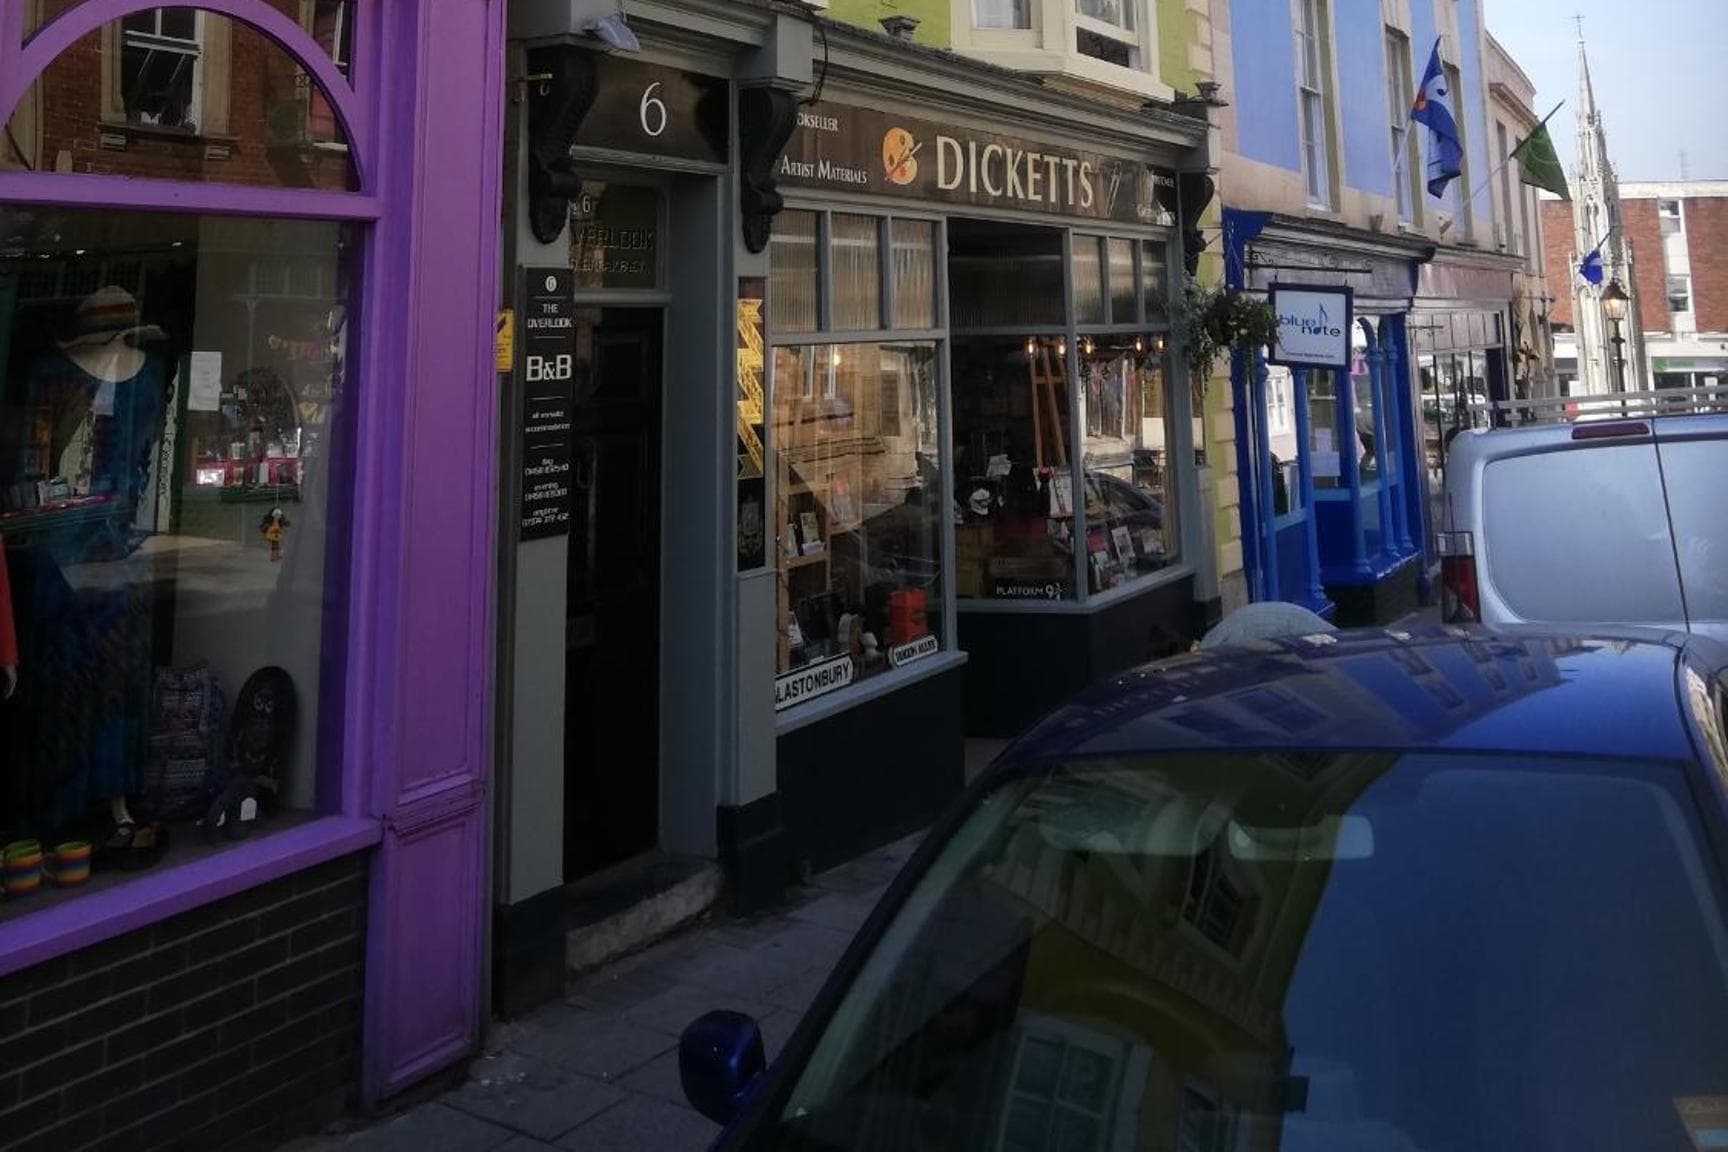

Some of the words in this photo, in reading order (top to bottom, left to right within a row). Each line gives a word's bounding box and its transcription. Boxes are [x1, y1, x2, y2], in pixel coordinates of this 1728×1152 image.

[640, 82, 667, 137] 6
[797, 112, 839, 131] OKSELLER
[936, 135, 1094, 209] DICKETTS
[542, 303, 560, 314] THE
[527, 317, 573, 329] OVERLOOK
[1279, 314, 1316, 327] blue
[526, 354, 572, 382] B&B
[995, 584, 1044, 596] PLATFORM
